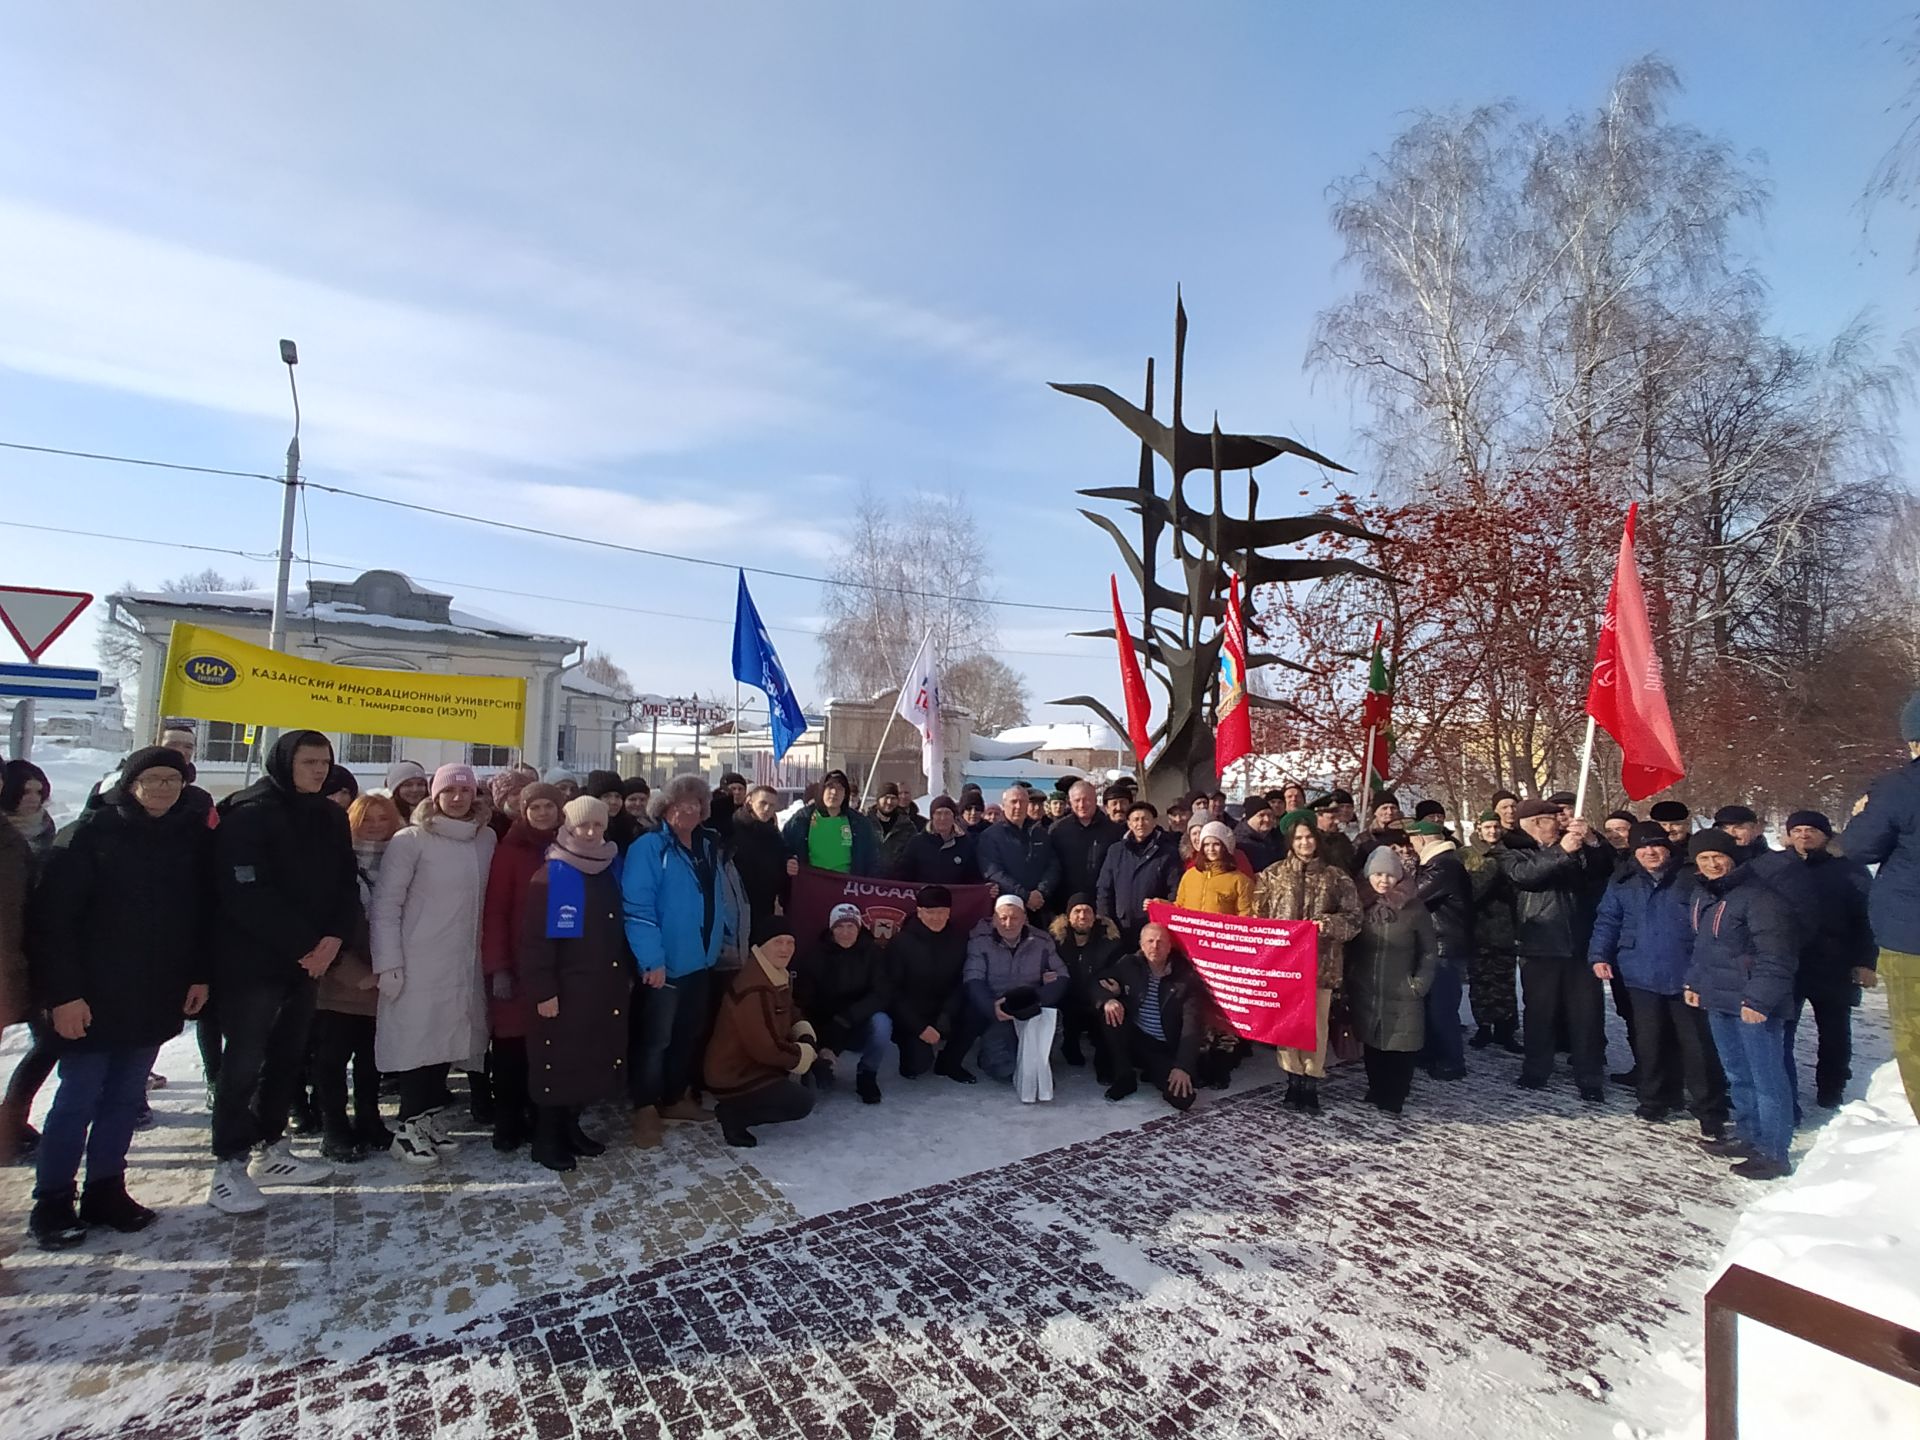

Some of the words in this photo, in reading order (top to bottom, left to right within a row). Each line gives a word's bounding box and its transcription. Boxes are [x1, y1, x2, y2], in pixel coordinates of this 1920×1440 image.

[194, 662, 229, 677] КИУ
[251, 666, 334, 690] КАЗАНСКИЙ
[337, 681, 452, 703] ИННОВАЦИОННЫЙ
[311, 693, 332, 703] им.
[336, 694, 357, 706] В.Г.
[360, 698, 434, 715] Тимирясова
[437, 708, 477, 720] (ИЭУП)
[843, 881, 919, 900] ДОСАА
[1170, 914, 1223, 930] ЮНАРМЕЙСКИЙ
[1224, 924, 1249, 933] ОТРЯД
[1193, 928, 1216, 939] ГЕРОЯ
[1216, 933, 1263, 945] СОВЕТСКОГО
[1264, 938, 1291, 947] СОЮЗА
[1232, 965, 1302, 980] ВСЕРОССИЙСКОГО
